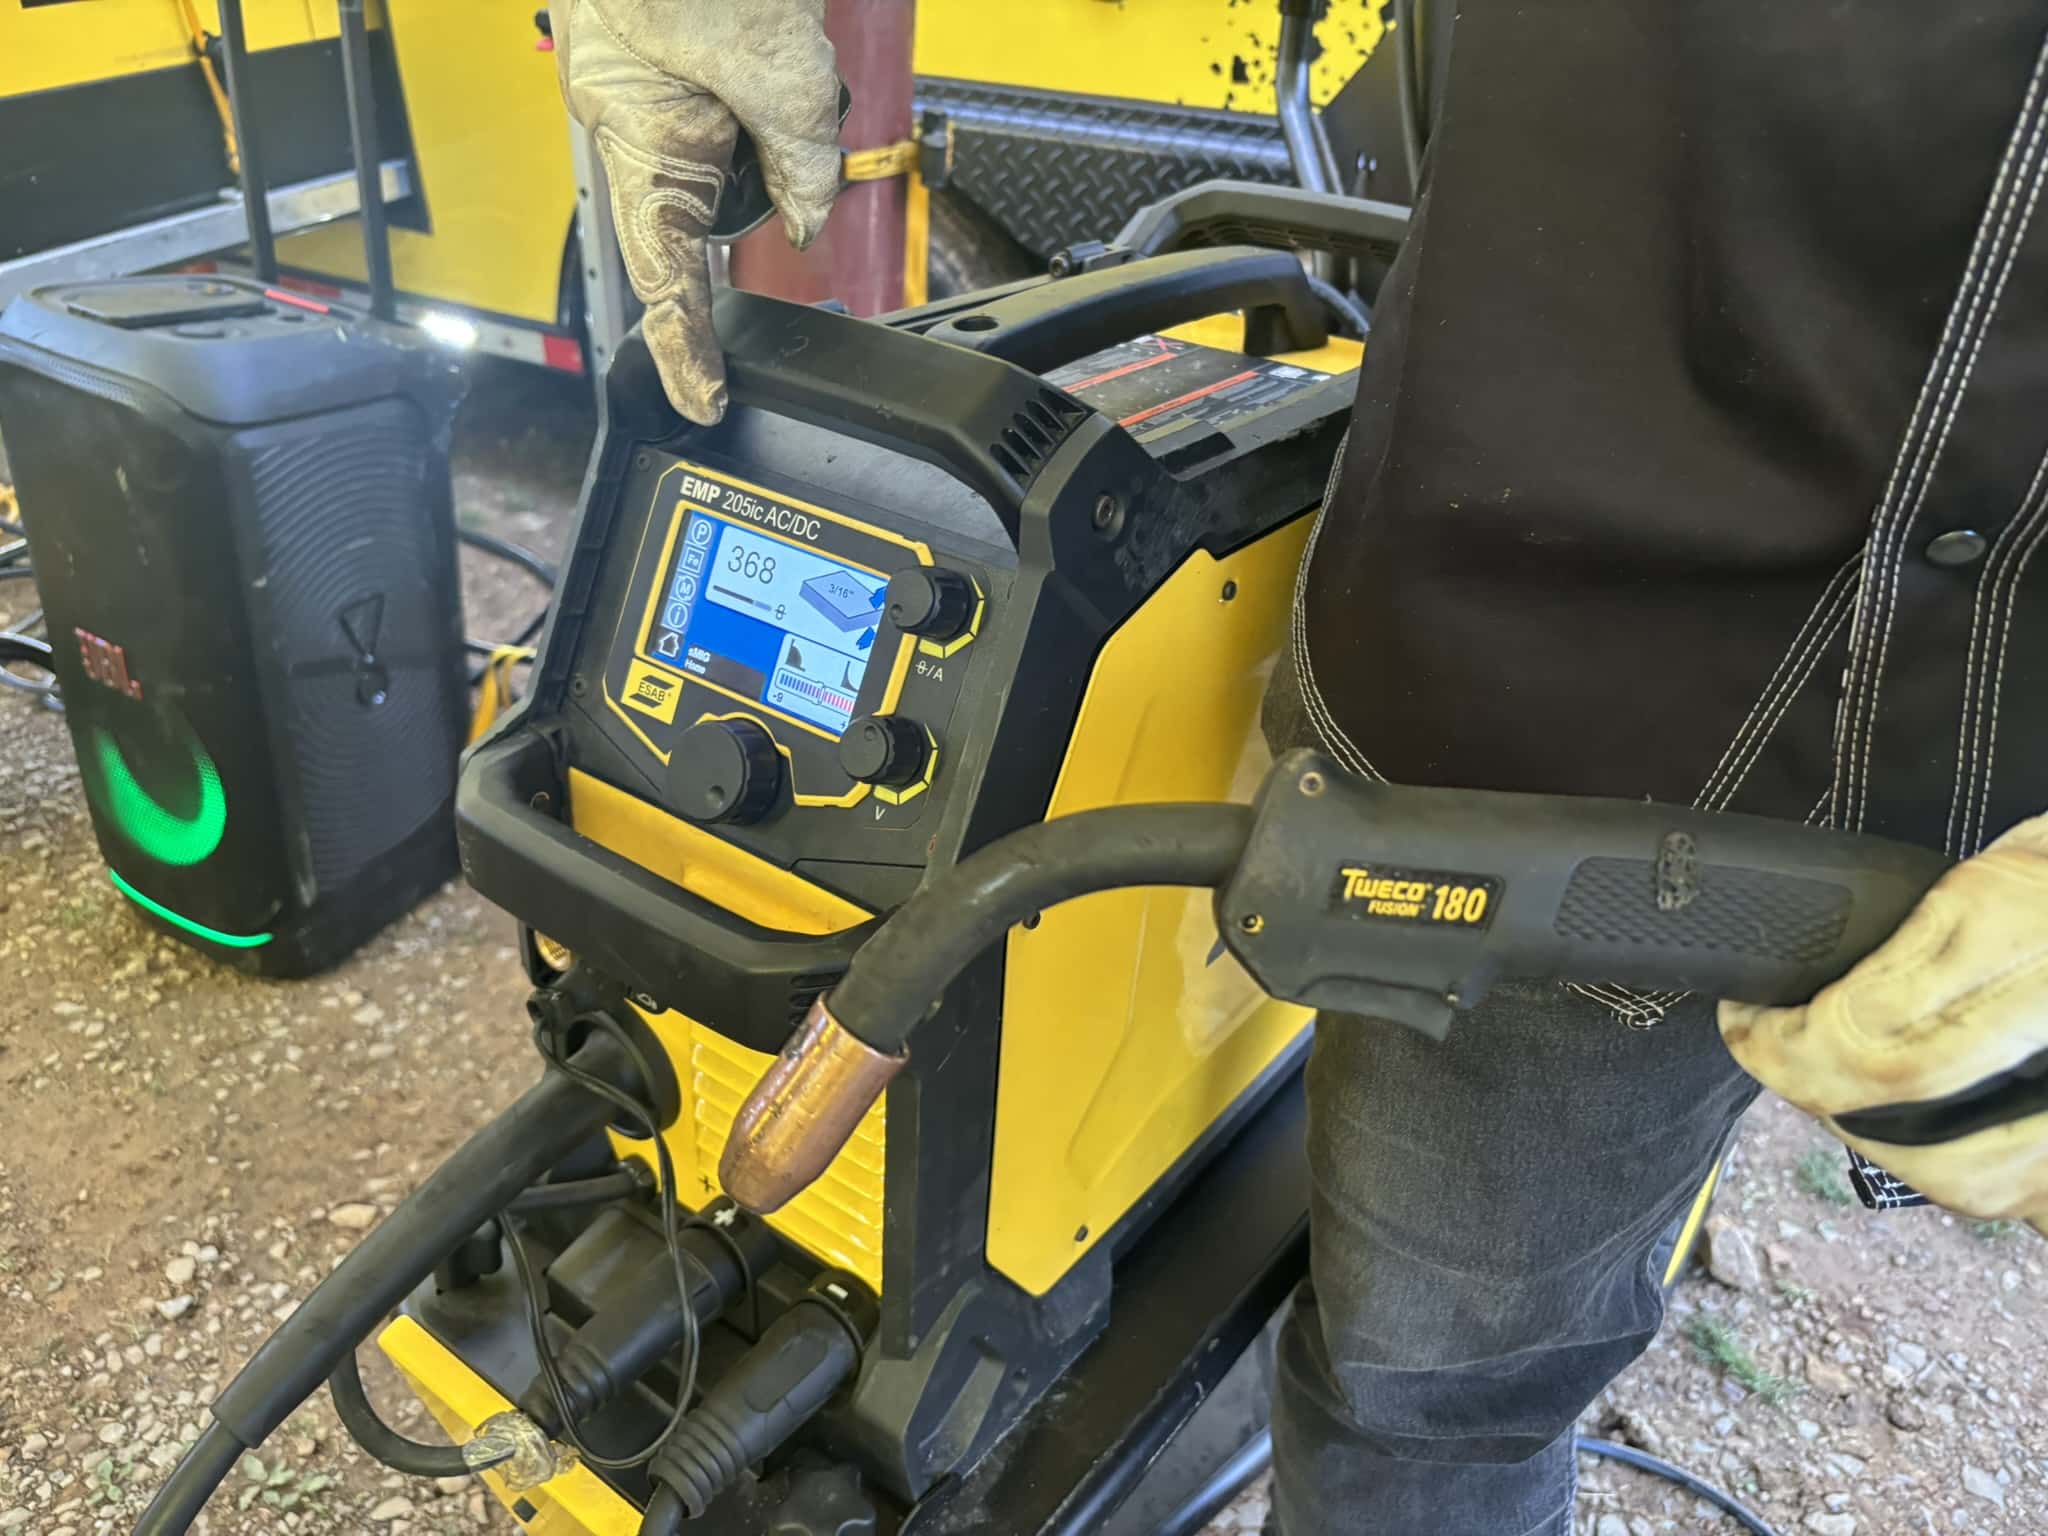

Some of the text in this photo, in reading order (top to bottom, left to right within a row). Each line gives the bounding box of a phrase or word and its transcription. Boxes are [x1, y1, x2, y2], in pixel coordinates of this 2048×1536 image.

[679, 475, 821, 540] EMP 205ic AC/DC
[727, 545, 777, 584] 368
[638, 681, 666, 701] ESAB
[874, 804, 886, 821] V
[1367, 899, 1421, 917] FUSION
[1431, 884, 1488, 923] 180
